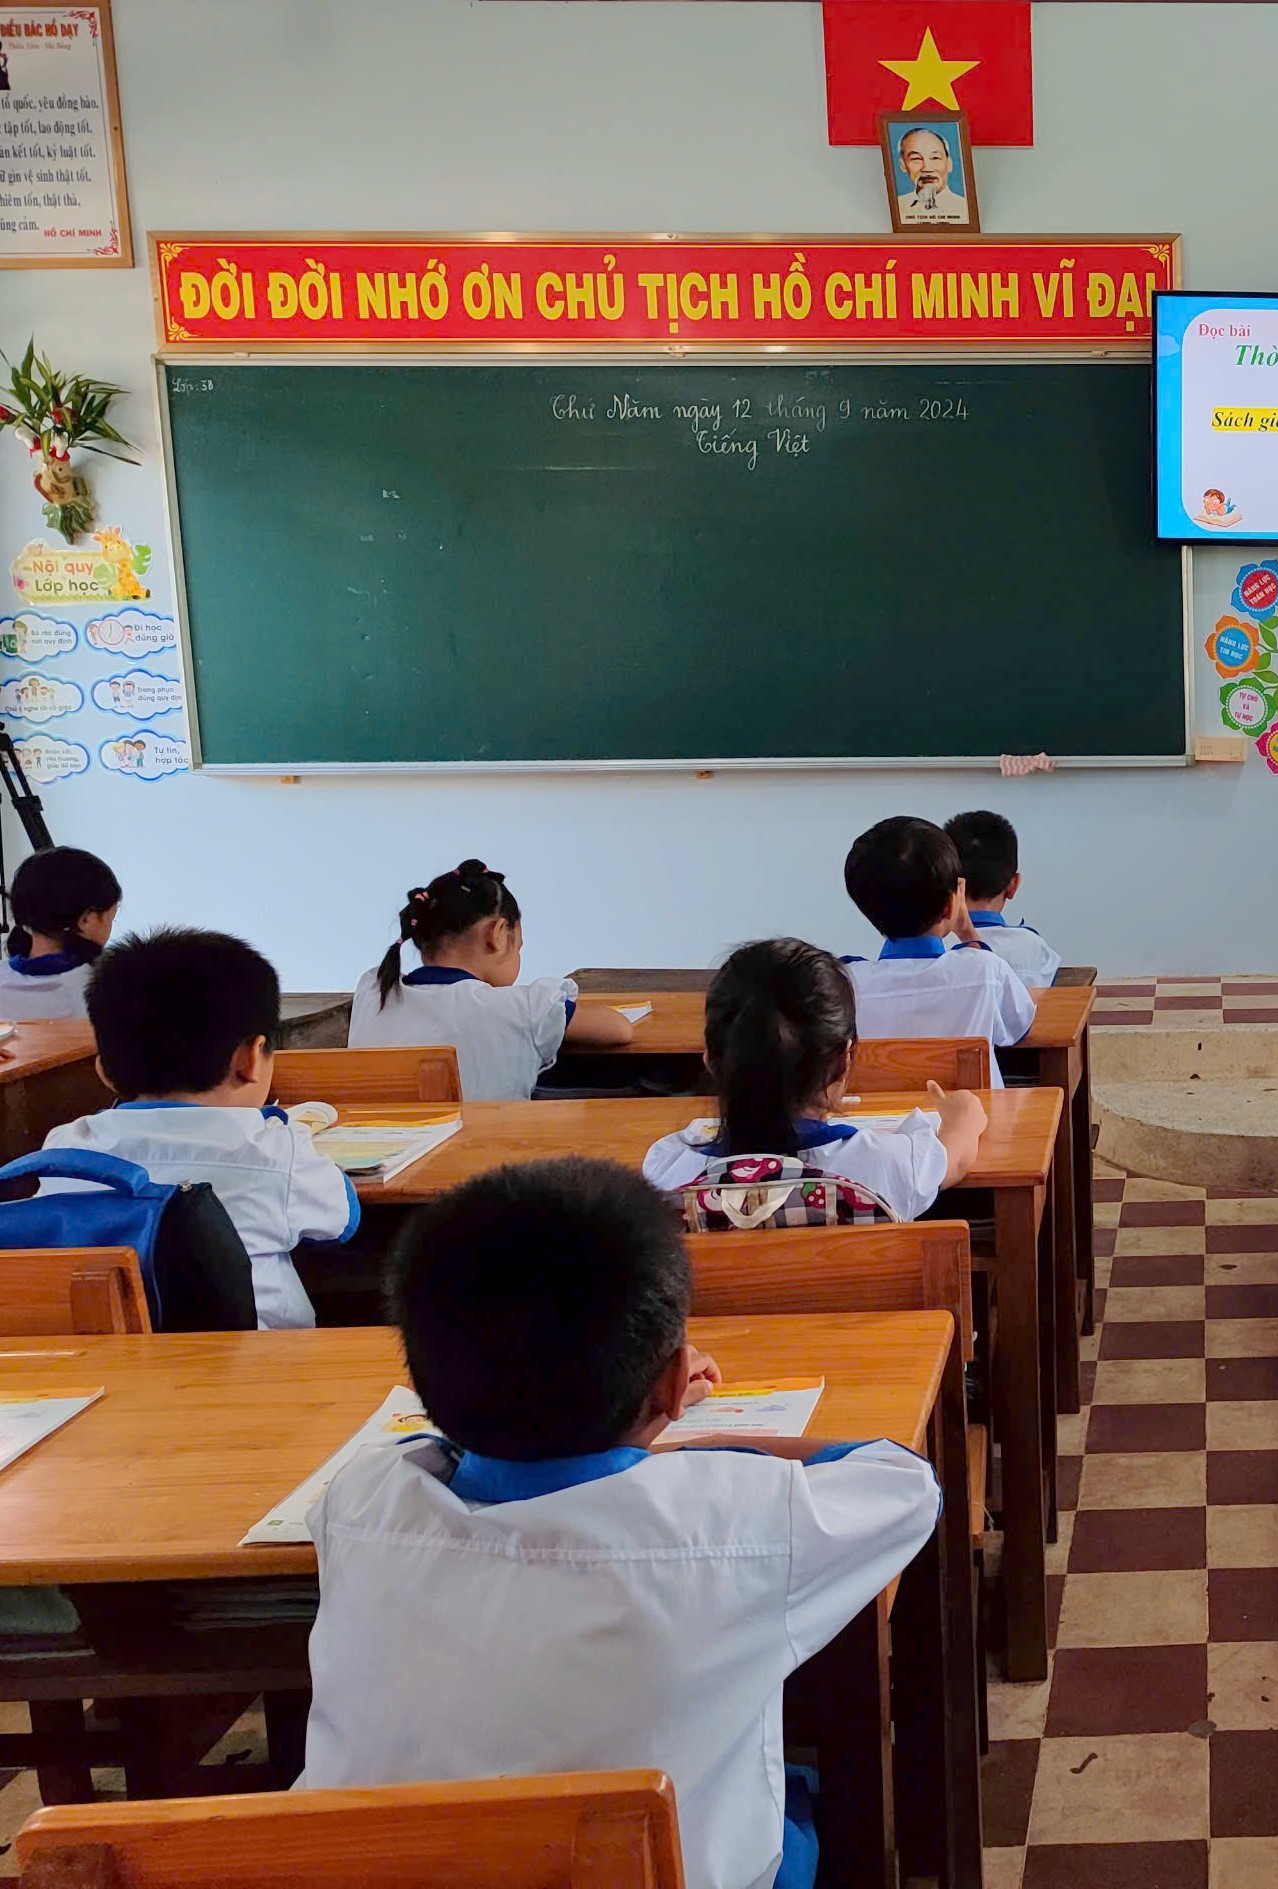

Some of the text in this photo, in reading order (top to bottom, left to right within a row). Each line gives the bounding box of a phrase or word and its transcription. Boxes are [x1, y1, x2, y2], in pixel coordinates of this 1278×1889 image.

[13, 94, 36, 113] quốc,
[4, 117, 92, 137] tập tốt, lao động tốt.
[12, 143, 27, 158] kết
[29, 143, 45, 158] tốt,
[60, 145, 77, 160] luật
[80, 143, 96, 158] tốt.
[36, 168, 54, 182] sinh
[56, 169, 73, 185] thật
[76, 166, 91, 182] tốt.
[24, 191, 41, 207] tốn,
[43, 193, 61, 209] thật
[19, 215, 39, 230] cảm.
[60, 227, 75, 237] CHÍ
[78, 229, 102, 237] MINH
[180, 258, 255, 320] ĐỜI
[267, 258, 343, 320] ĐỜI
[358, 258, 448, 320] NHỚ
[462, 262, 523, 320] ƠN
[536, 254, 625, 320] CHỦ
[637, 271, 739, 334] TỊCH
[753, 252, 812, 320] HỒ
[824, 259, 898, 320] CHÍ
[911, 271, 1020, 319] MINH
[1032, 258, 1076, 319] VĨ
[1198, 323, 1251, 339] Đọc bài
[606, 394, 662, 420] Năm
[672, 398, 723, 432] ngày
[732, 398, 753, 420] 12
[766, 396, 827, 432] tháng
[839, 398, 851, 420] 9
[862, 398, 910, 420] năm
[919, 398, 970, 421] 2024
[1212, 411, 1254, 428] Sách
[697, 427, 810, 470] Tiếng Việt
[33, 559, 94, 576] Nội quy
[35, 578, 99, 595] Lớp học
[146, 625, 162, 633] học
[135, 634, 157, 642] đúng
